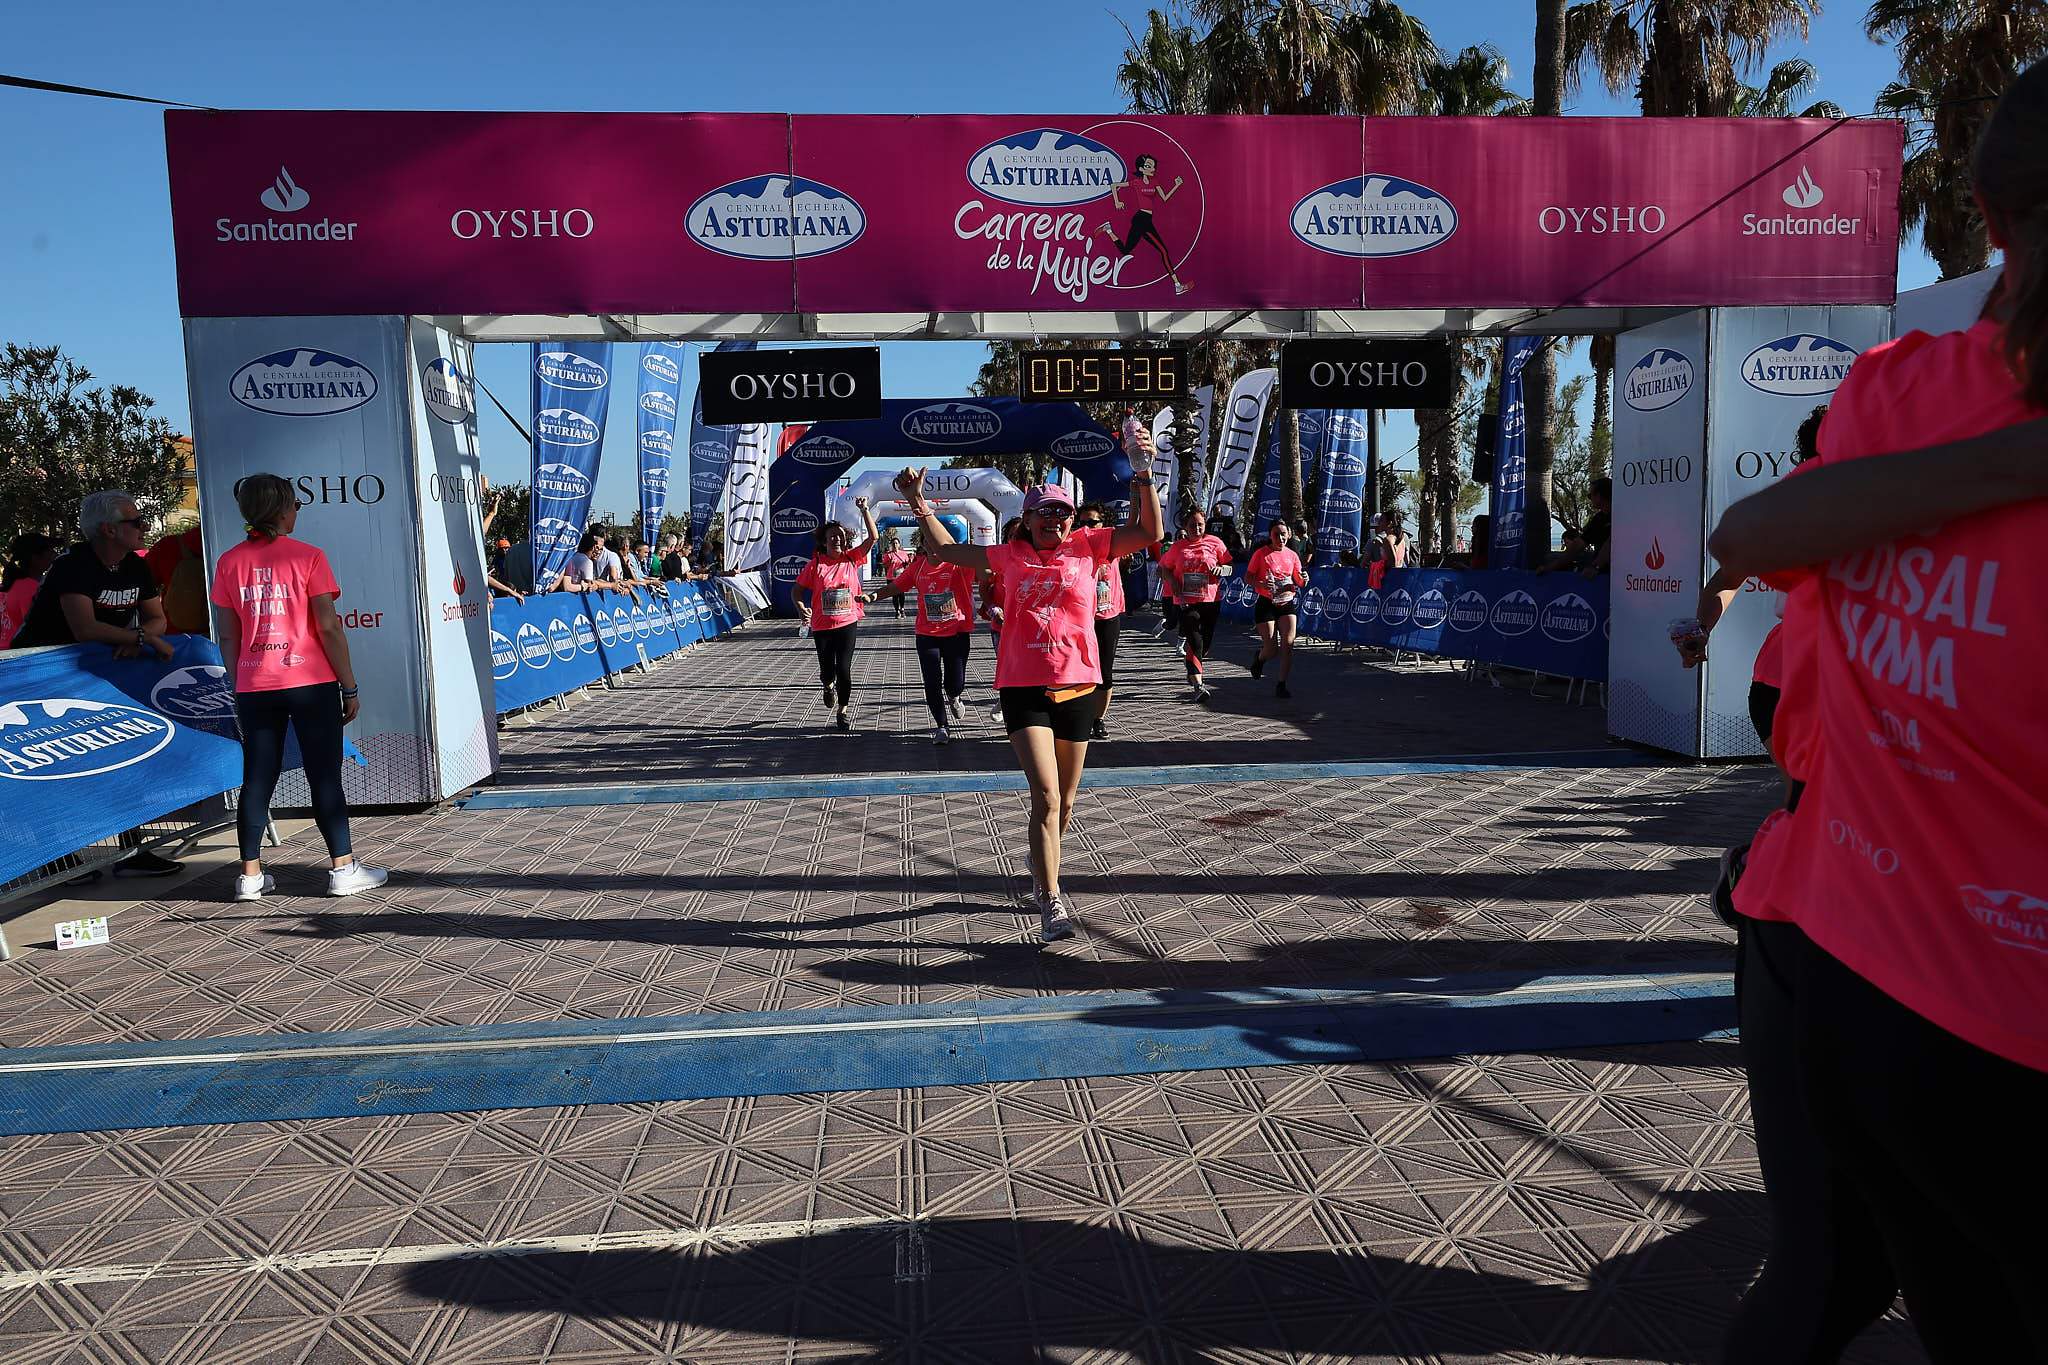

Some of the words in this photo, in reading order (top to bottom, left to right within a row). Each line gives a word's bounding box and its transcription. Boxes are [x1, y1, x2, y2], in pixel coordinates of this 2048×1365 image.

[1003, 154, 1054, 164] CENTRAL
[1059, 155, 1110, 164] LECHERA
[980, 157, 1115, 187] ASTURIANA
[726, 203, 783, 213] CENTRAL
[1329, 203, 1382, 212] CENTRAL
[1386, 202, 1440, 211] LECHERA
[216, 217, 358, 242] Santander
[450, 208, 594, 240] OYSHO
[700, 206, 853, 238] ASTURIANA
[954, 200, 1086, 241] Carrera
[1303, 205, 1445, 236] ASTURIANA
[1538, 205, 1667, 235] OYSHO
[1742, 213, 1861, 236] Santander
[987, 242, 1012, 270] de
[1016, 241, 1034, 270] la
[1031, 237, 1134, 303] Mujer
[1768, 355, 1808, 363] CENTRAL
[1811, 355, 1852, 363] LECHERA
[263, 371, 311, 380] CENTRAL
[314, 371, 362, 379] LECHERA
[538, 360, 602, 385] ASTURIANA
[1031, 357, 1175, 393] 00:57:36
[1309, 361, 1428, 387] OYSHO
[241, 374, 368, 400] ASTURIANA
[730, 372, 856, 400] OYSHO
[1627, 374, 1688, 400] ASTURIANA
[537, 418, 593, 441] ASTURIANA
[909, 416, 994, 435] ASTURIANA
[795, 448, 850, 458] ASTURIANA
[1056, 443, 1110, 454] ASTURIANA
[1622, 455, 1692, 487] OYSHO
[1735, 451, 1806, 479] OYS
[233, 474, 385, 505] SHO
[430, 473, 476, 506] OYSHO
[892, 474, 970, 492] SHO
[1320, 499, 1359, 509] TURIANA
[773, 517, 816, 528] ASTURIANA
[253, 567, 272, 583] TU
[774, 565, 801, 576] ASTURI
[1626, 574, 1682, 594] Santander
[1824, 543, 2008, 637] OSAL
[442, 600, 480, 622] Santander
[1450, 606, 1484, 622] ASTURIANA
[1493, 606, 1534, 626] ASTURIANA
[1544, 608, 1589, 632] ASTURIANA
[4, 724, 69, 744] CENTRAL
[67, 709, 129, 729] LECHERA
[0, 717, 167, 774] ASTURIANA
[1974, 906, 2048, 940] TURIA
